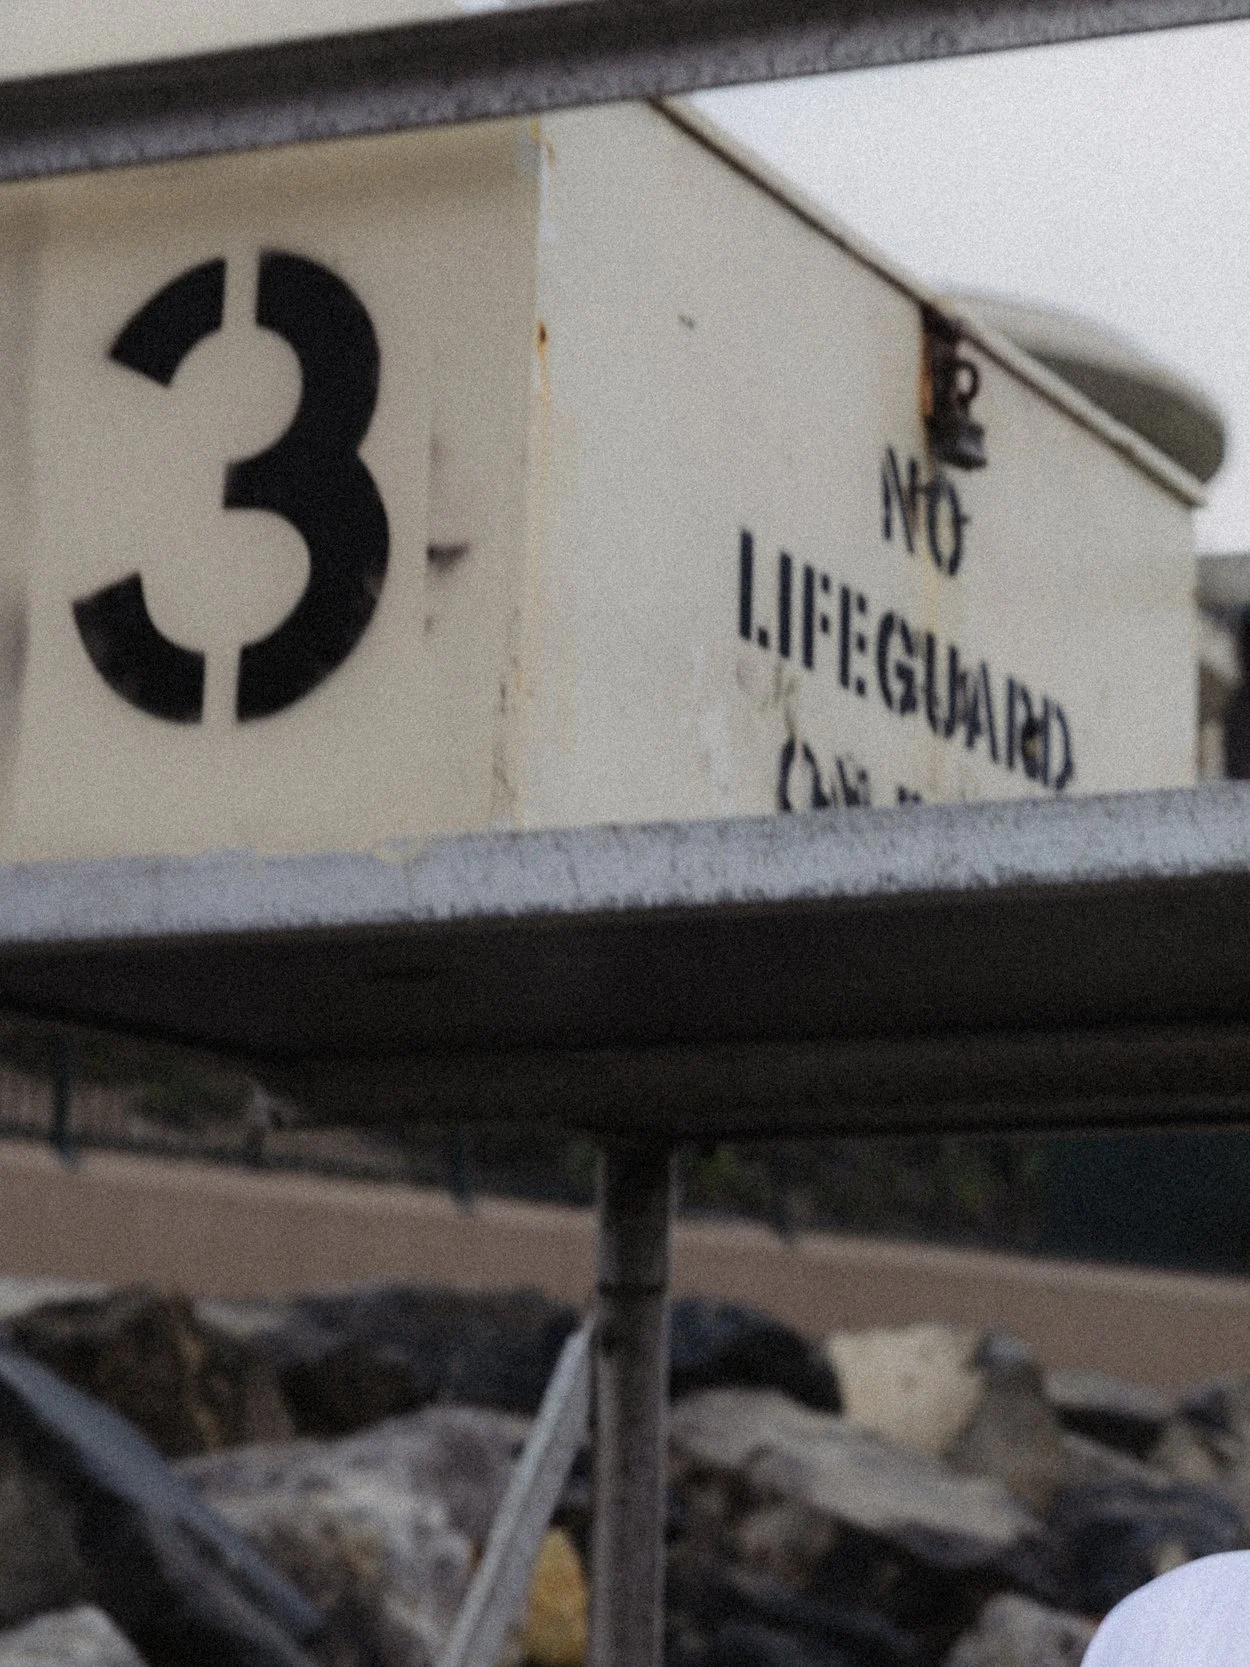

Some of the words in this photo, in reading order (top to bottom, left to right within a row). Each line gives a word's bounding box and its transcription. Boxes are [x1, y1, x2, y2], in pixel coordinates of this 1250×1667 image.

[71, 245, 391, 727] 3
[880, 443, 966, 577] NO
[738, 528, 1075, 791] LIFEGUARD
